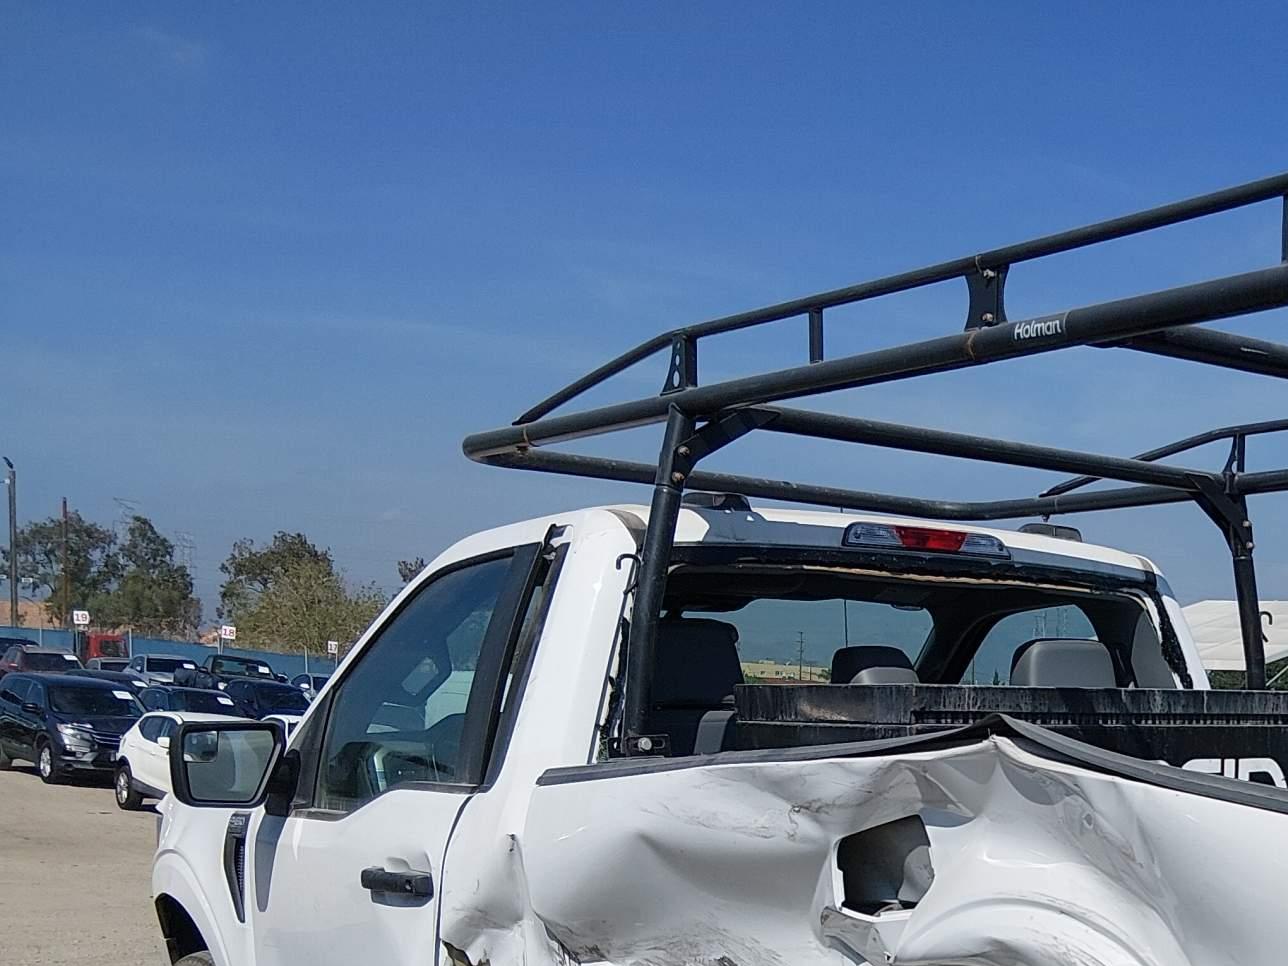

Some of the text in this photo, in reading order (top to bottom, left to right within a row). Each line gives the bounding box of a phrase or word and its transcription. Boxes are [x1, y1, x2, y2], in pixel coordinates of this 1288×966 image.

[1014, 319, 1062, 340] Holman
[74, 612, 88, 622] 19
[223, 628, 235, 637] 18
